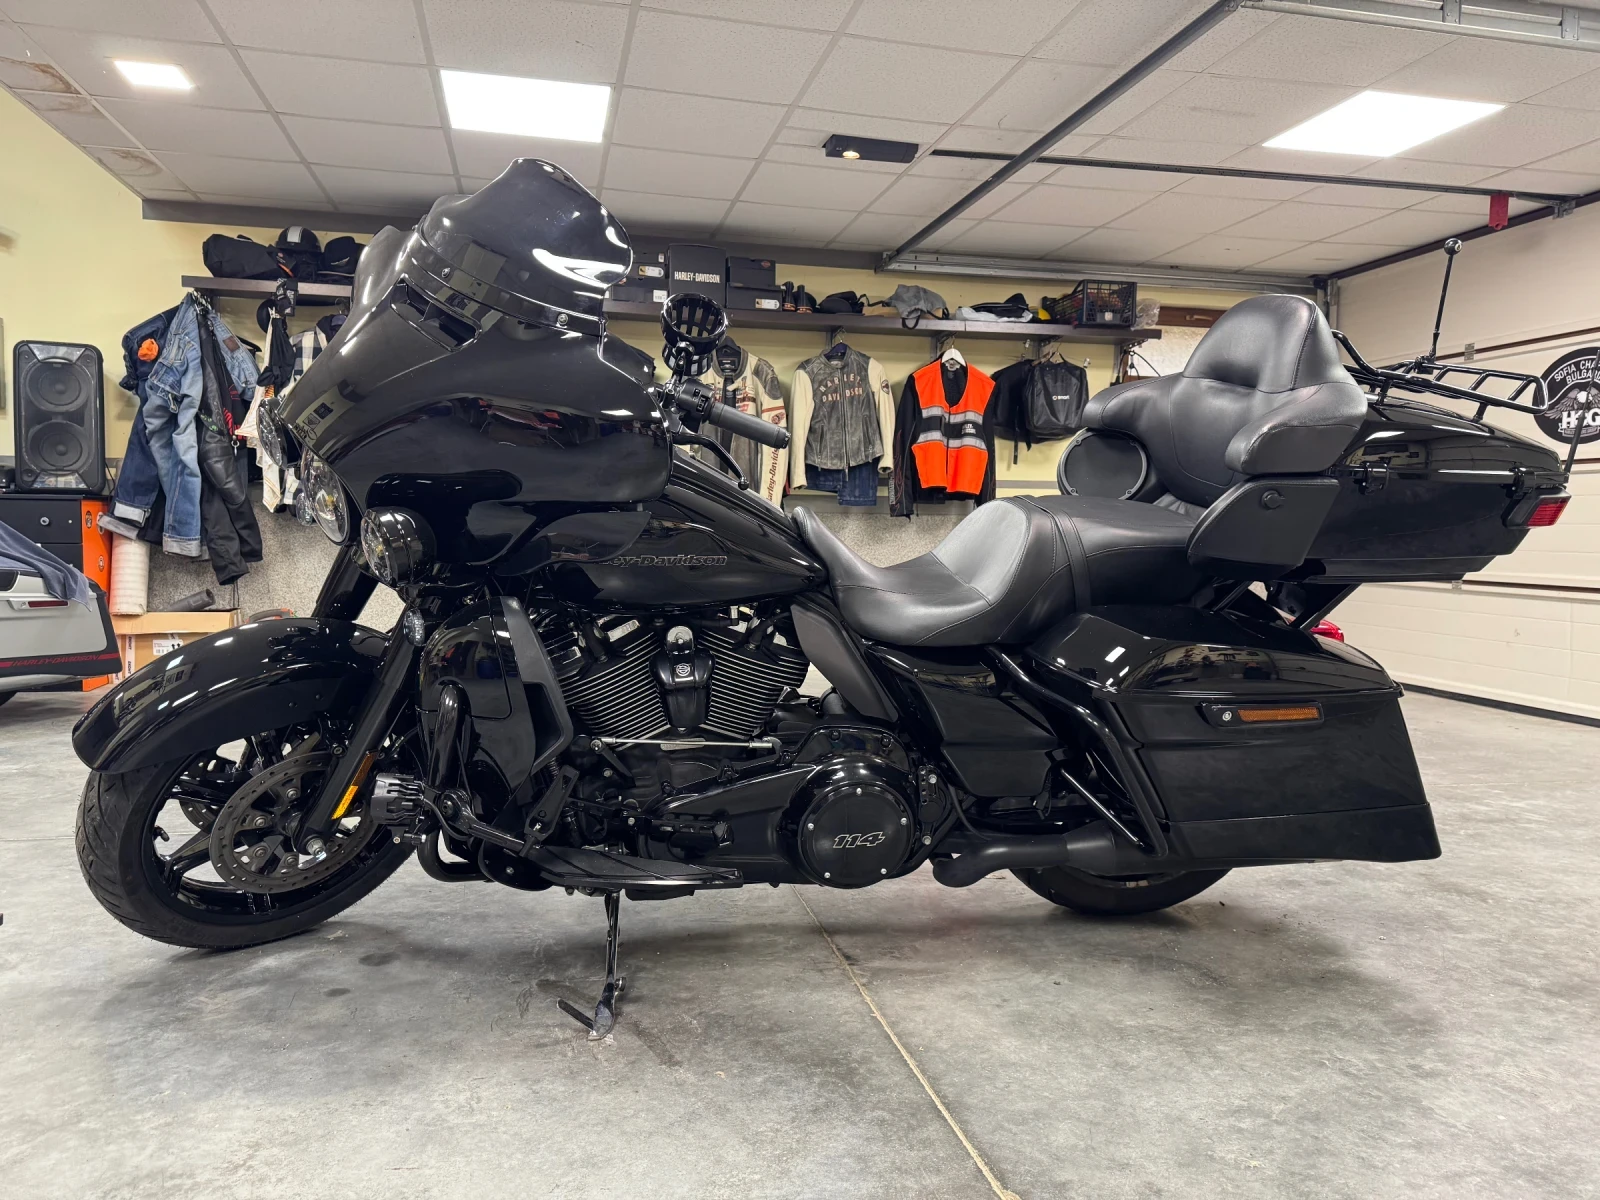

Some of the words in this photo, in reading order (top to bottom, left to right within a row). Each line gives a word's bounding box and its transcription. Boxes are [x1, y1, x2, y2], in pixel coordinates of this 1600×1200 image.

[674, 271, 721, 283] HARLEY-DAVIDSON
[1554, 364, 1577, 381] SOFIA
[12, 655, 99, 666] HARLEY-DAVIDSON
[833, 831, 885, 848] 114
